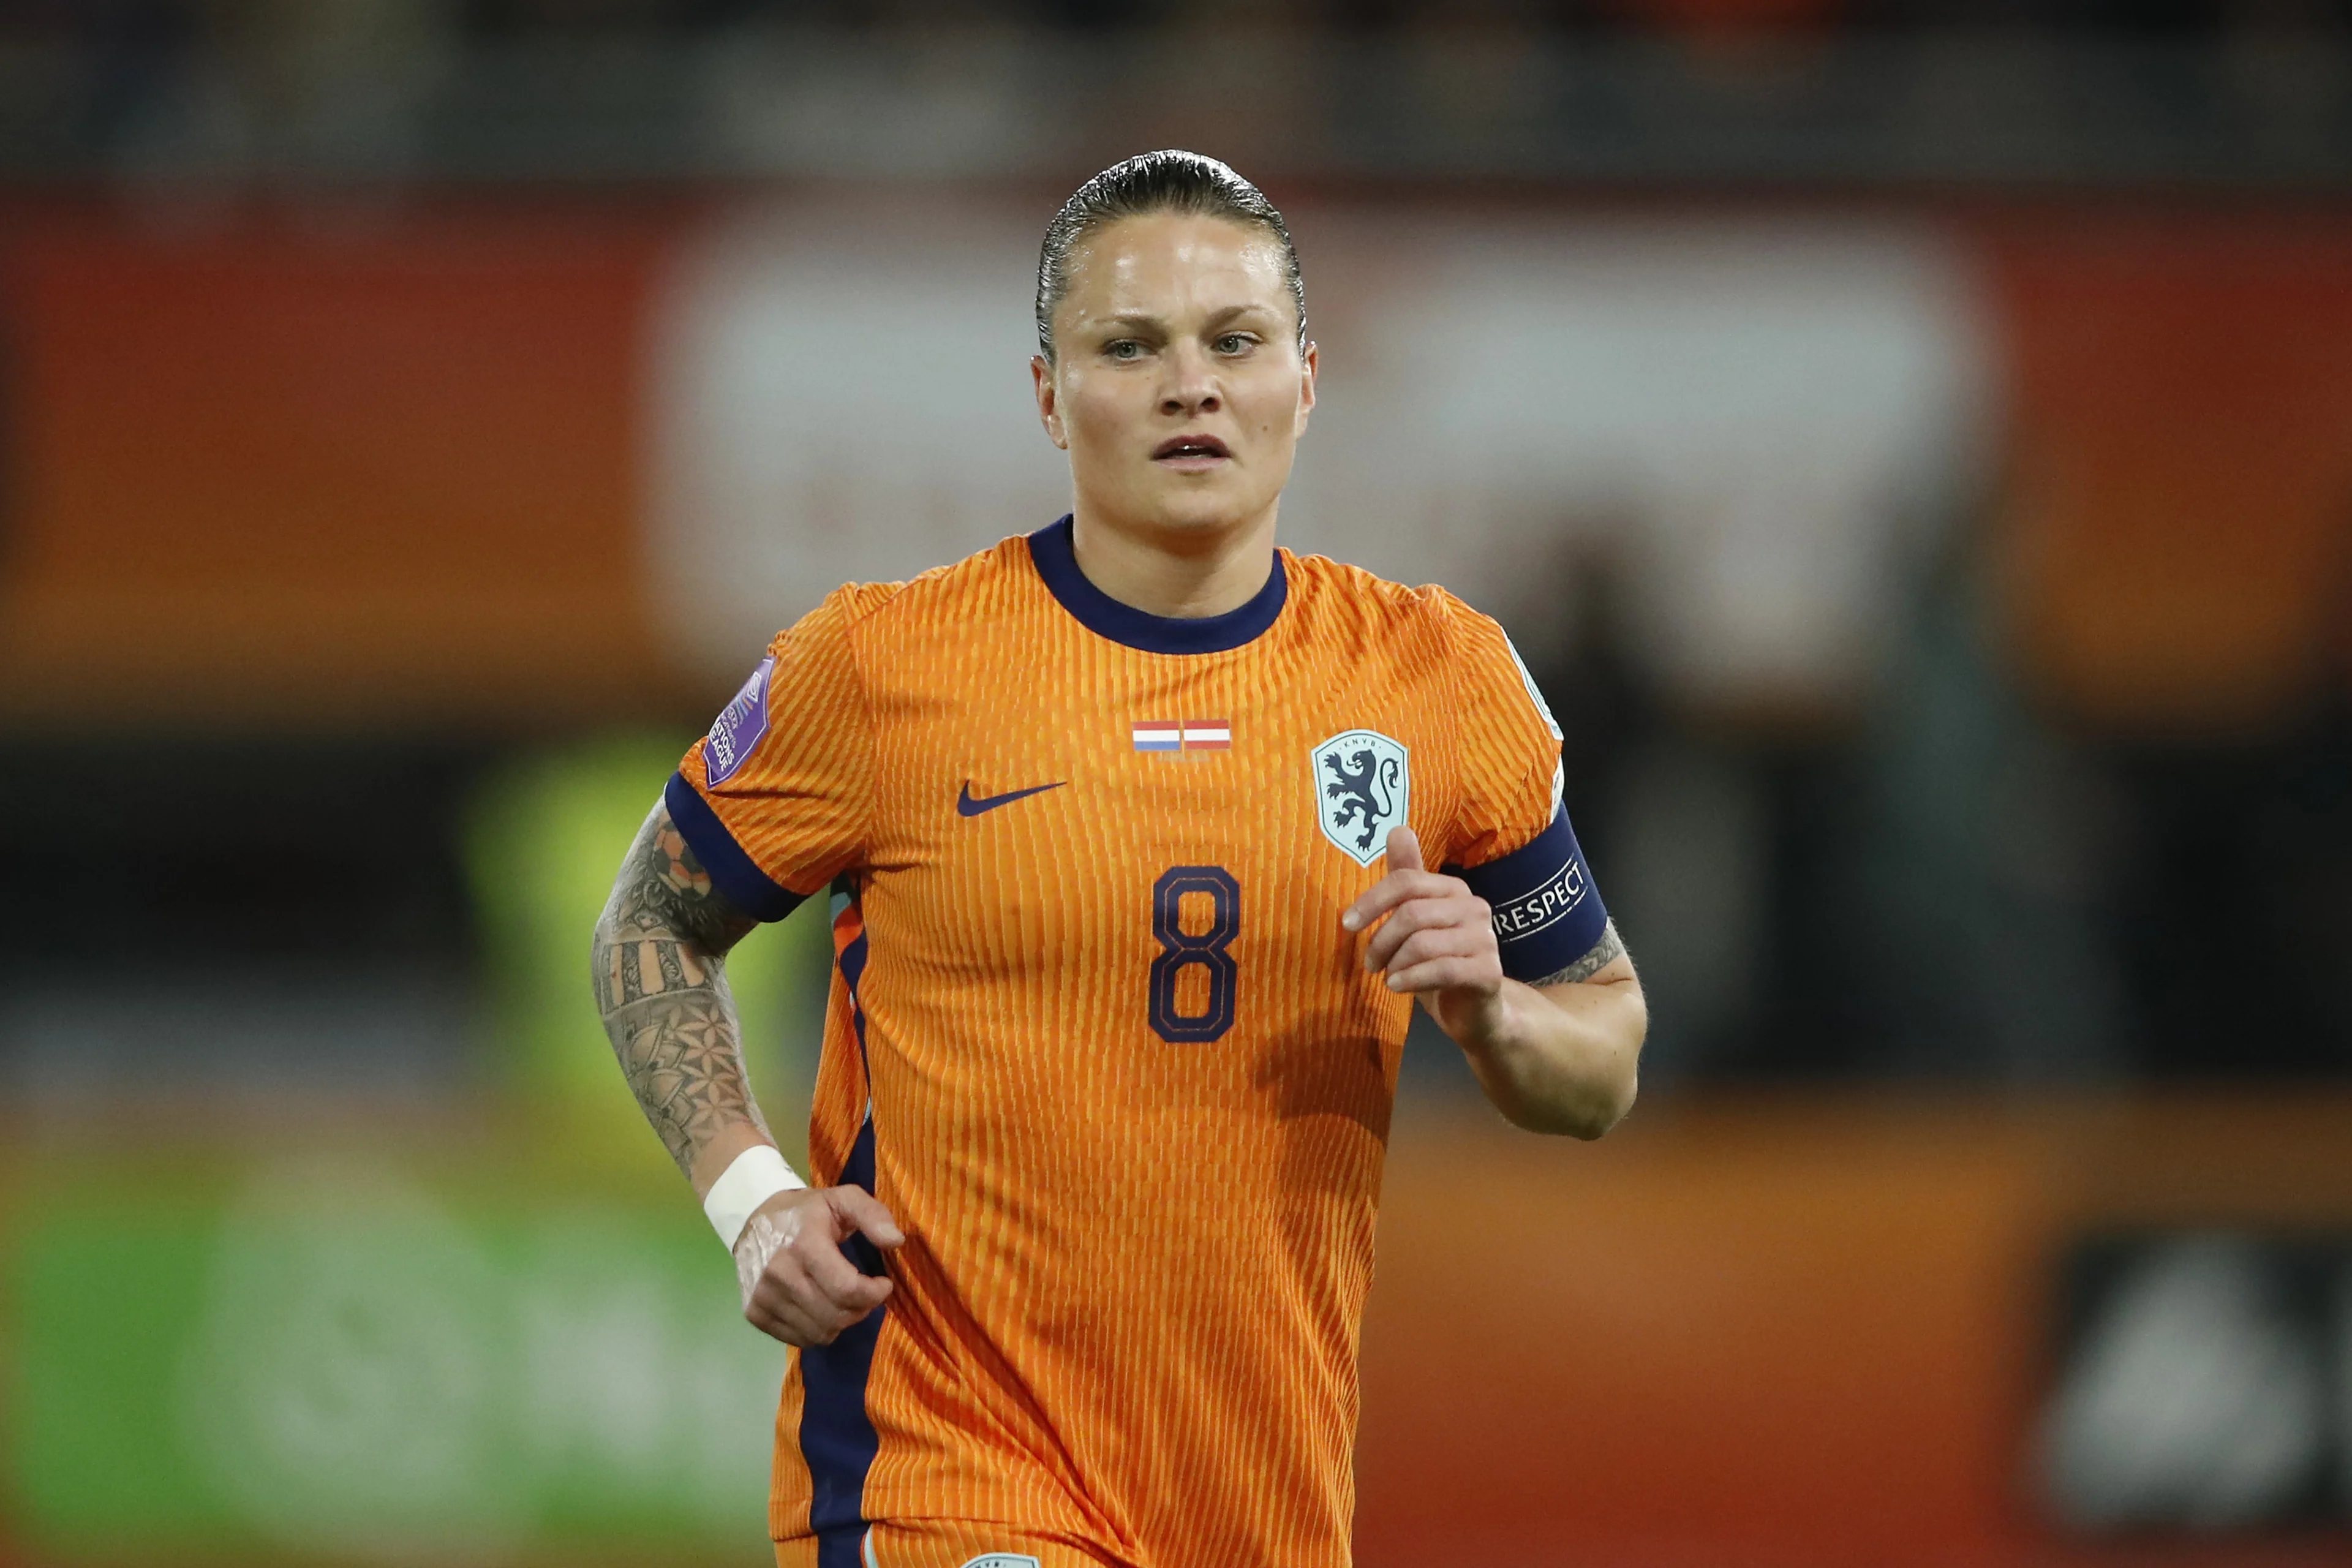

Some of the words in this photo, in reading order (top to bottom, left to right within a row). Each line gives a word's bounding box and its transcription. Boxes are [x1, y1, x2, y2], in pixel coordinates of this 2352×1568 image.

[709, 729, 728, 772] EAGUE
[714, 722, 735, 766] ATIONS
[1343, 738, 1376, 748] KNVB
[1493, 861, 1584, 935] RESPECT
[1148, 865, 1240, 1043] 8
